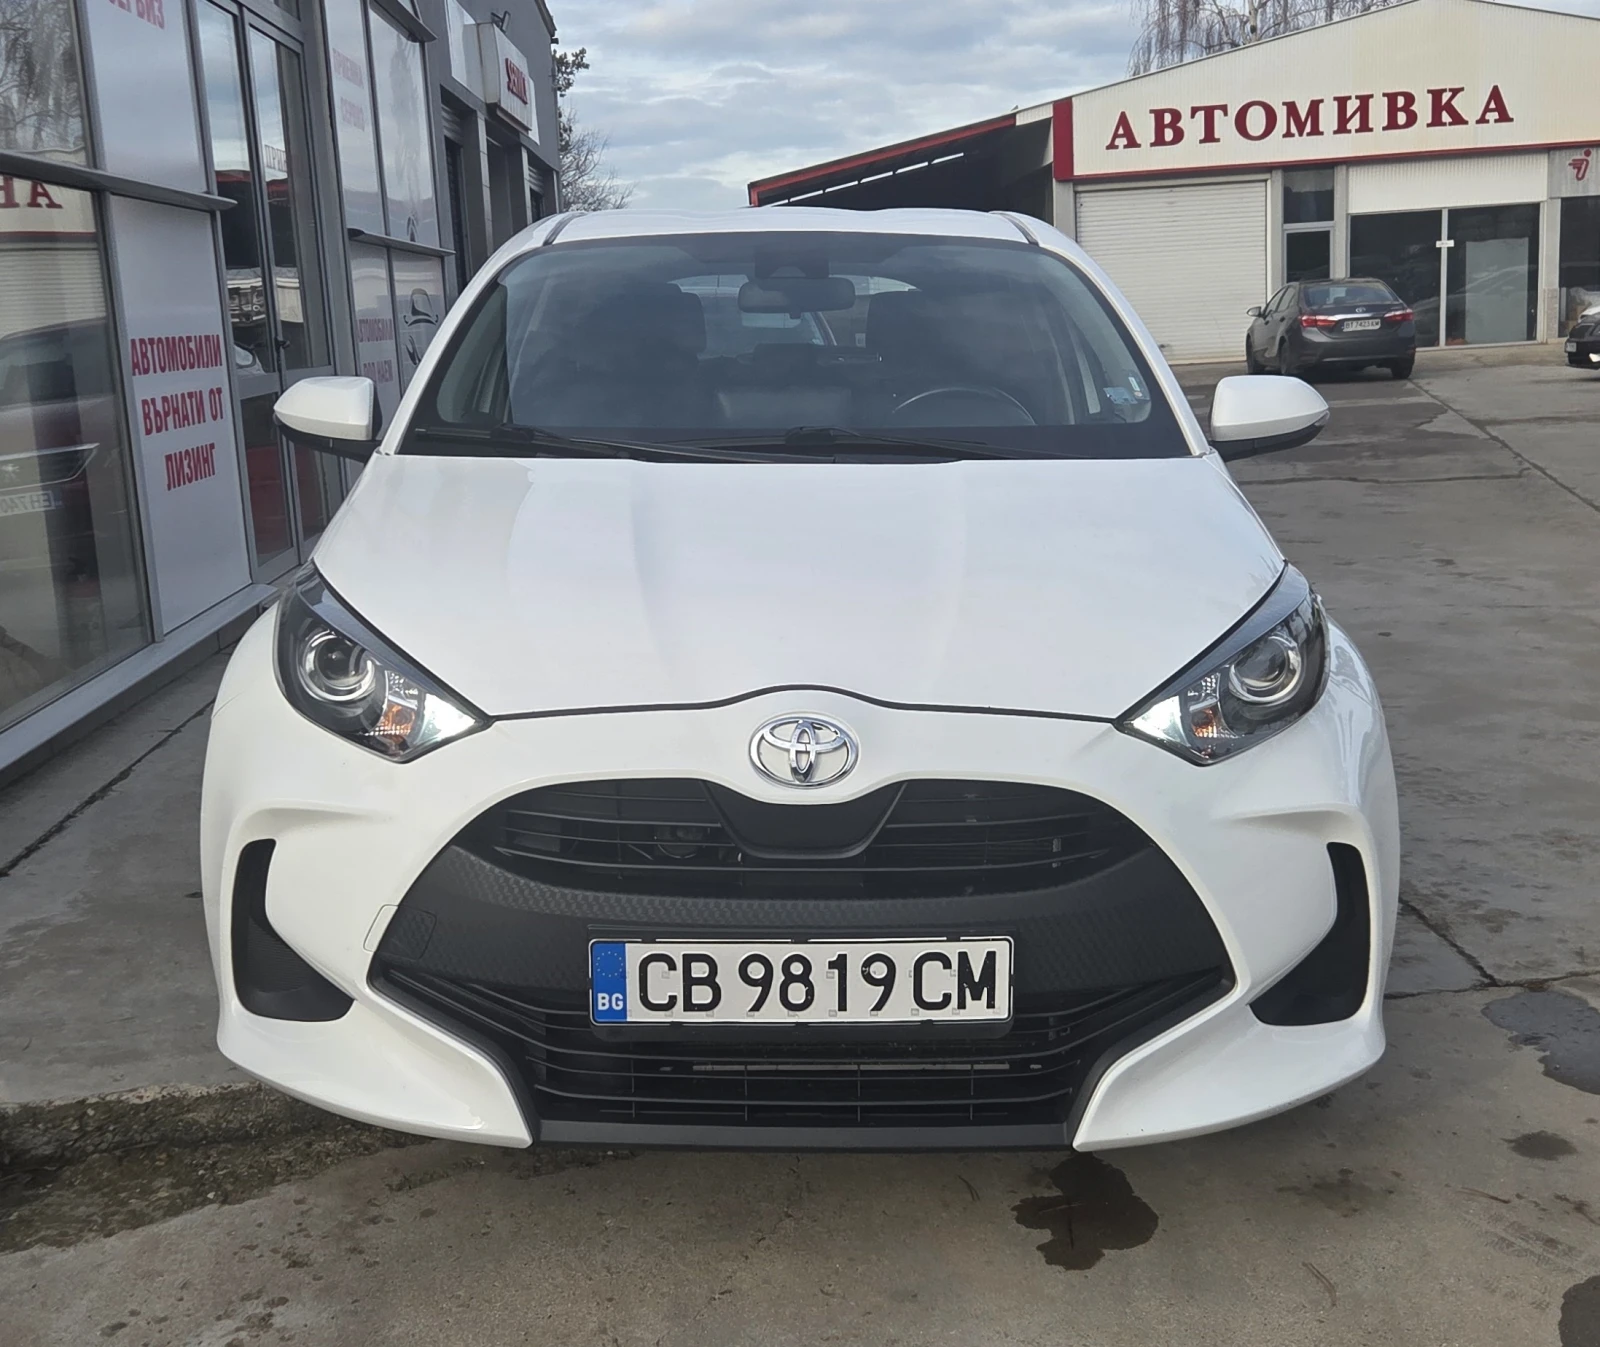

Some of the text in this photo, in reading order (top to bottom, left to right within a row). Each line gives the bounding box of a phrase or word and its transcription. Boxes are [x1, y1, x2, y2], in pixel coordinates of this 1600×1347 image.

[1106, 85, 1514, 150] АВТОМИВКА
[130, 334, 222, 376] АВТОМОБИЛИ
[141, 387, 223, 435] ВЪРНАТИ ОТ
[165, 443, 215, 491] ЛИЗИНГ
[597, 993, 624, 1010] BG
[639, 951, 997, 1012] CB 9819 CM
